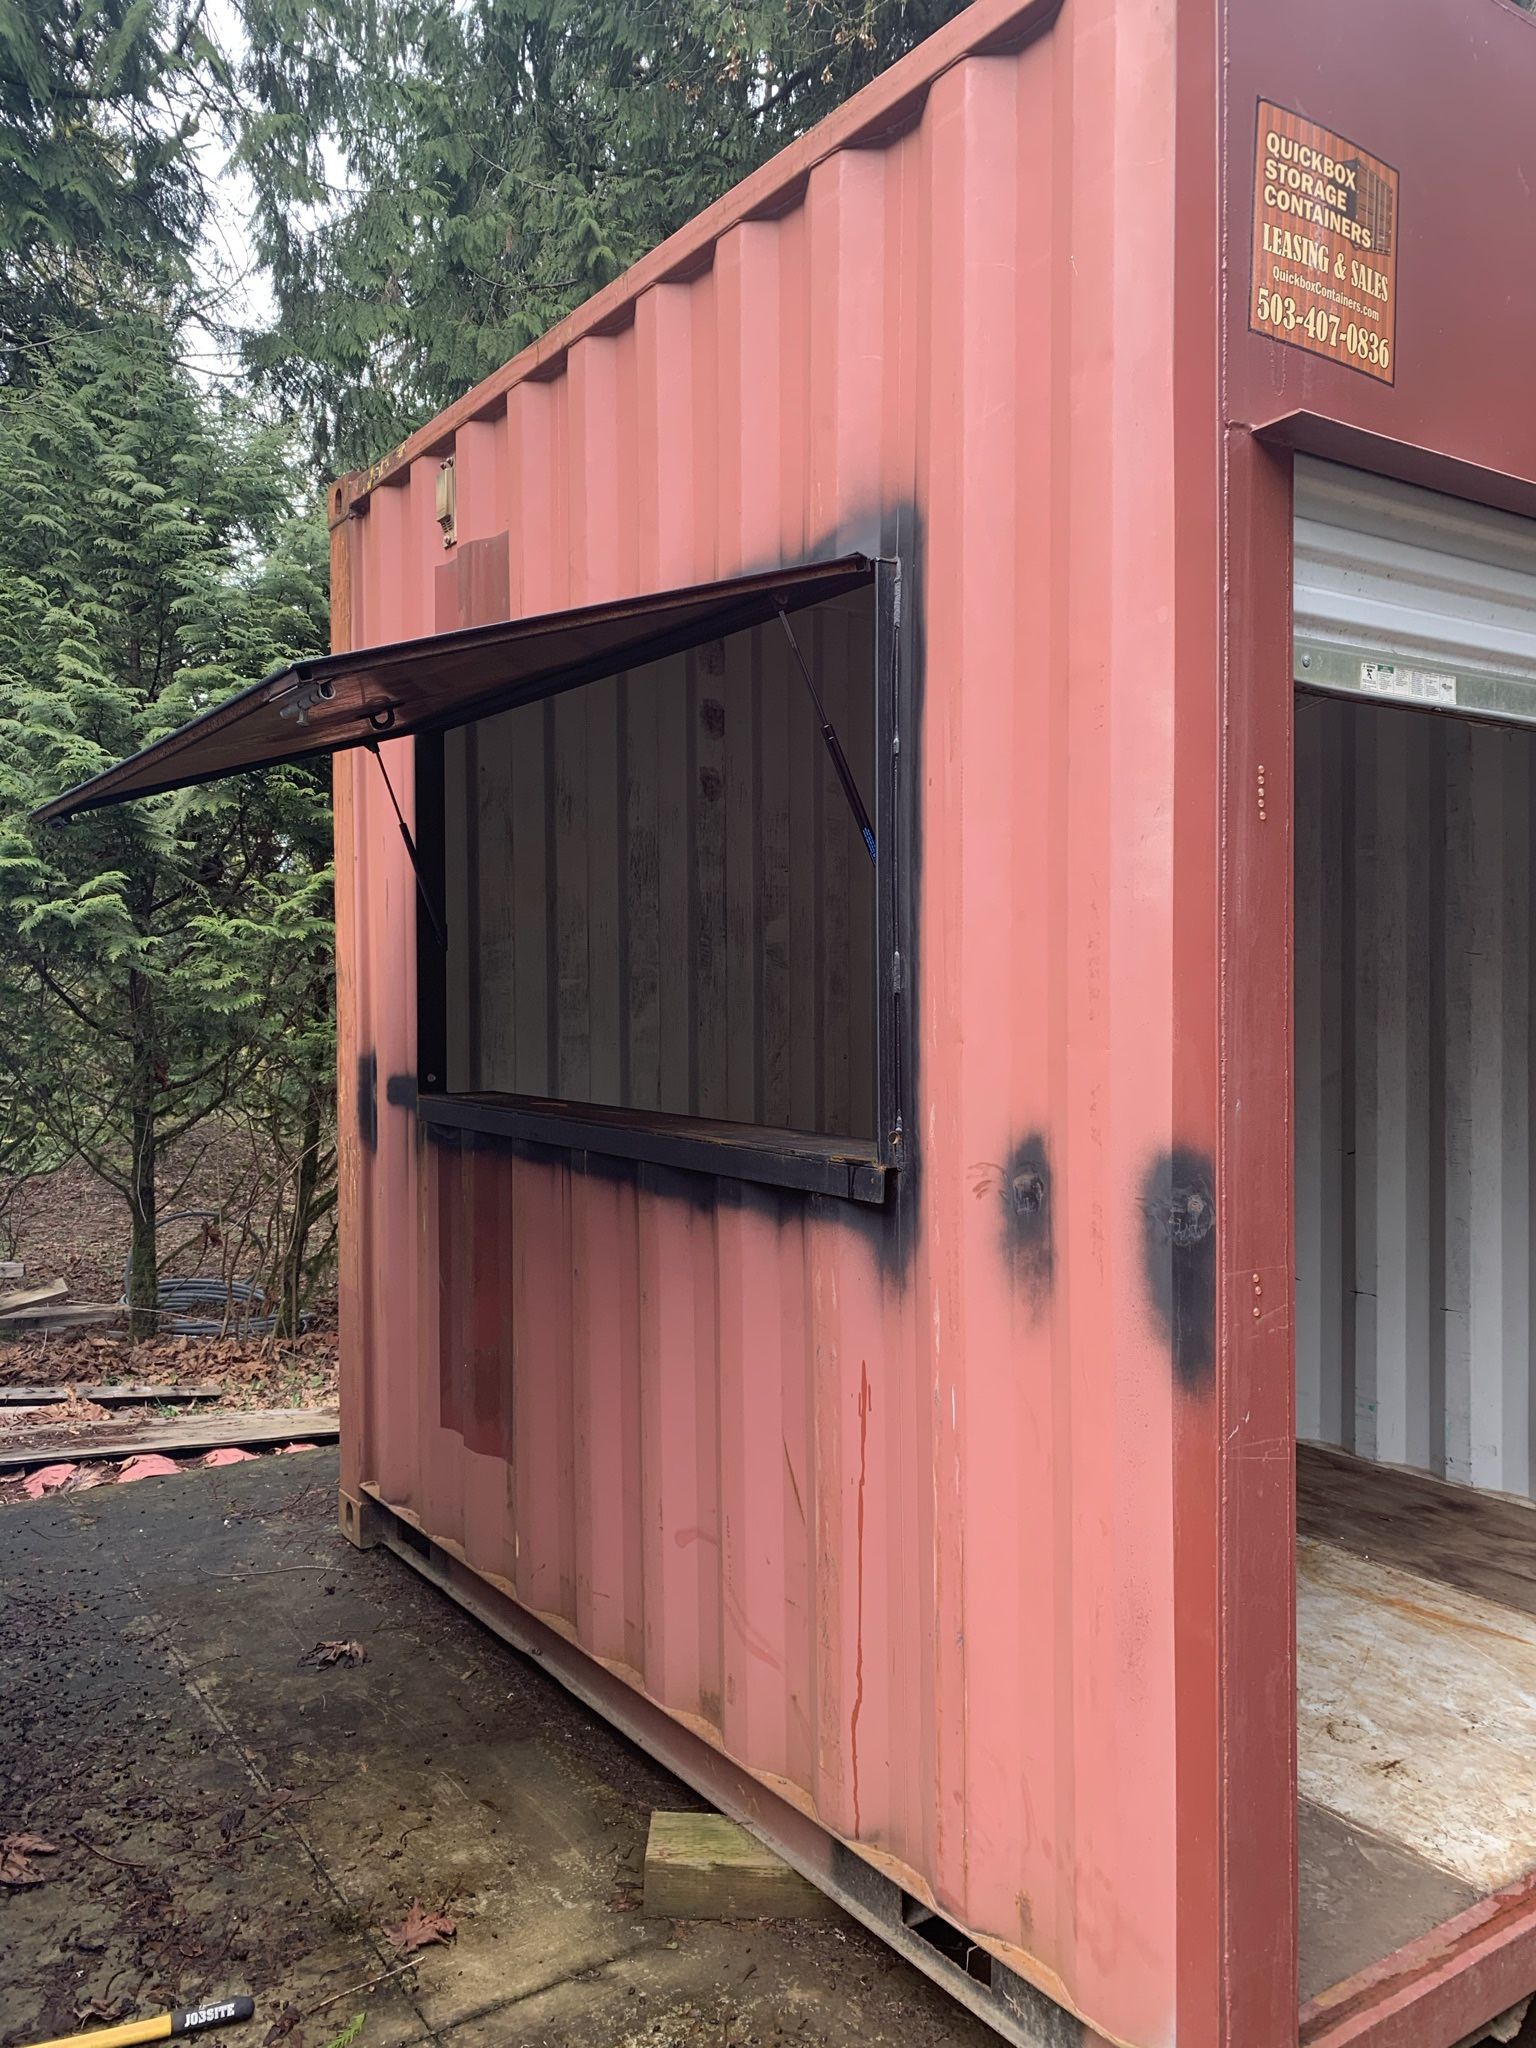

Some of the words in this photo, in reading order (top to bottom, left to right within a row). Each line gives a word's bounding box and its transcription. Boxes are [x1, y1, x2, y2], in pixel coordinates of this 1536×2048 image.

[1265, 159, 1347, 211] STORAGE
[1266, 132, 1356, 191] QUICKBOX
[1264, 185, 1371, 248] CONTAINERS
[1262, 223, 1330, 274] LEASING
[1333, 252, 1347, 280] &
[1351, 260, 1388, 302] SALES
[1272, 265, 1379, 321] QuickboxContainers.com
[1257, 288, 1389, 369] 503-407-0836
[184, 2003, 235, 2028] JOBSITE
